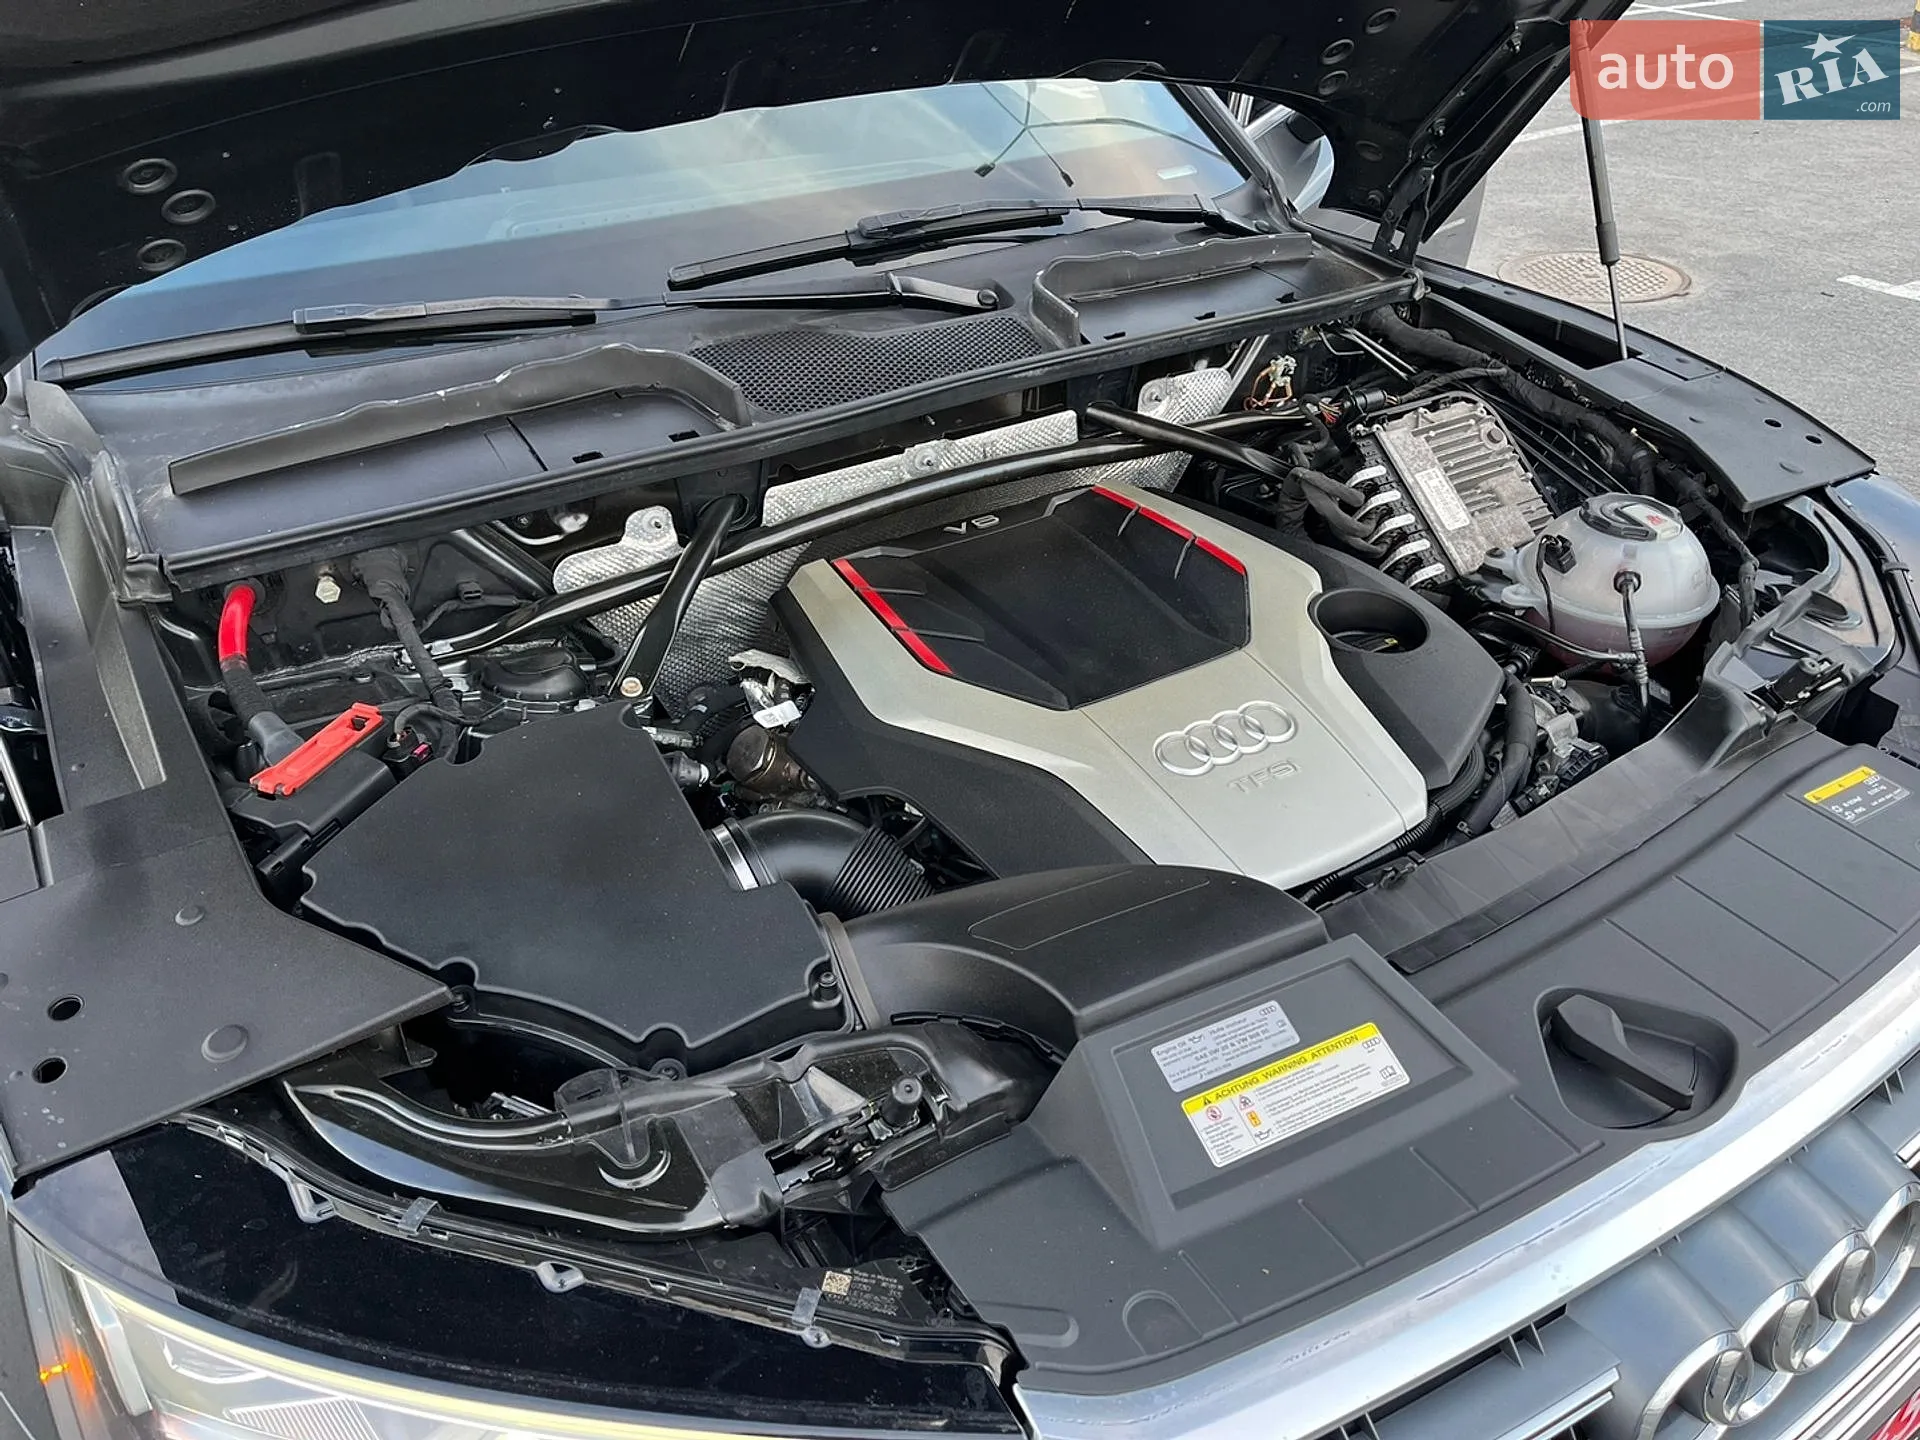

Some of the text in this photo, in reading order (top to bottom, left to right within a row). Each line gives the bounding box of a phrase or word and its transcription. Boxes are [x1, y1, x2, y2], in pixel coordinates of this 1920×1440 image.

[1215, 1077, 1260, 1101] ACHTUNG
[1263, 1057, 1308, 1080] WARNING
[1310, 1034, 1359, 1060] ATTENTION
